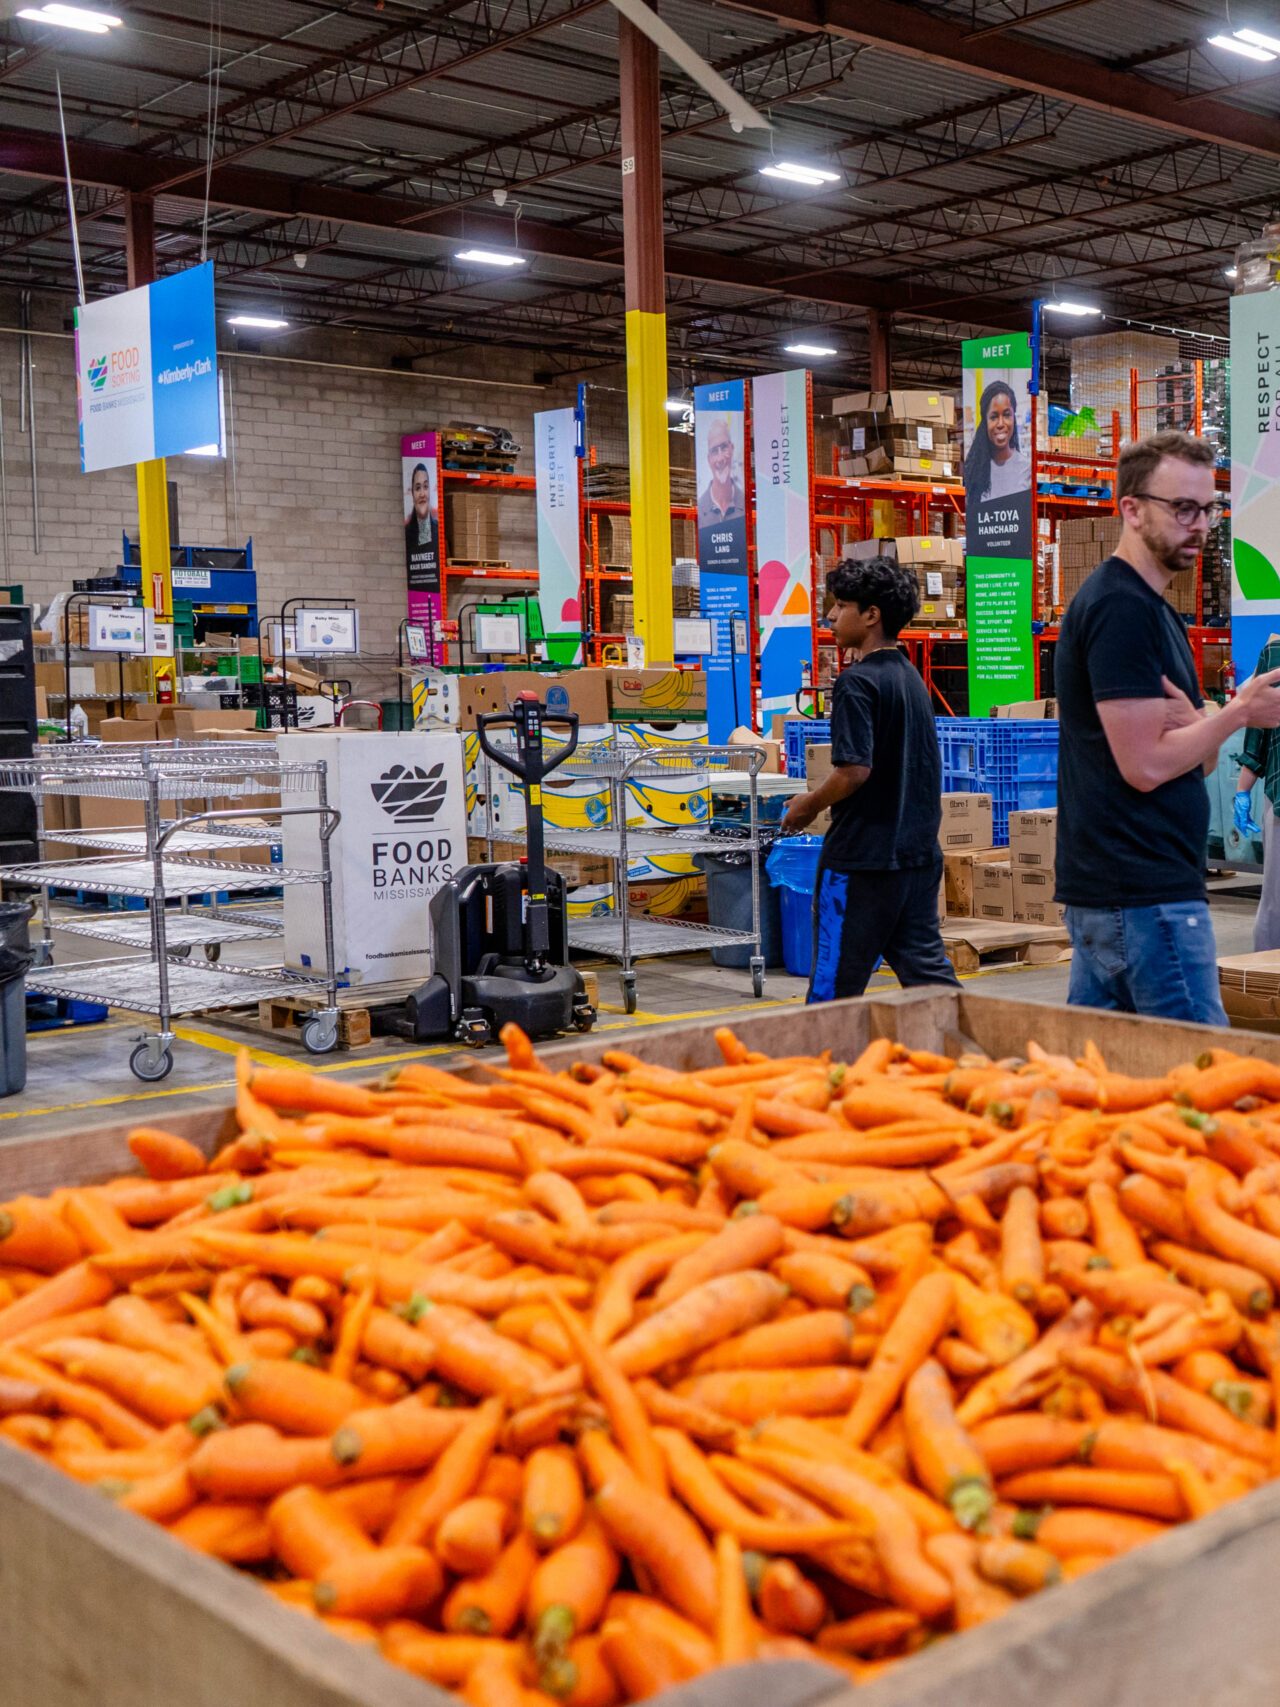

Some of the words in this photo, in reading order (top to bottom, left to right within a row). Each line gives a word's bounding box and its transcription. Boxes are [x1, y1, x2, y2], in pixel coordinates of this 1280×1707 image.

[624, 159, 634, 172] S9
[982, 344, 1012, 359] MEET
[111, 347, 140, 373] FOOD
[163, 356, 212, 384] Kimberly-Clark
[111, 370, 140, 388] SORTING
[1257, 331, 1270, 434] RESPECT
[708, 390, 730, 402] MEET
[411, 440, 426, 451] MEET
[780, 403, 791, 484] MINDSET
[549, 424, 557, 508] INTEGRITY
[772, 439, 780, 485] BOLD
[557, 464, 565, 508] FIRST
[977, 509, 1019, 523] LA-TOYA
[978, 524, 1019, 535] HANCHARD
[711, 533, 733, 544] CHRIS
[715, 545, 730, 553] LANG
[411, 552, 434, 562] NAVNEET
[623, 681, 642, 690] Dole
[372, 839, 452, 866] FOOD
[373, 863, 454, 888] BANKS
[629, 891, 648, 901] Dole
